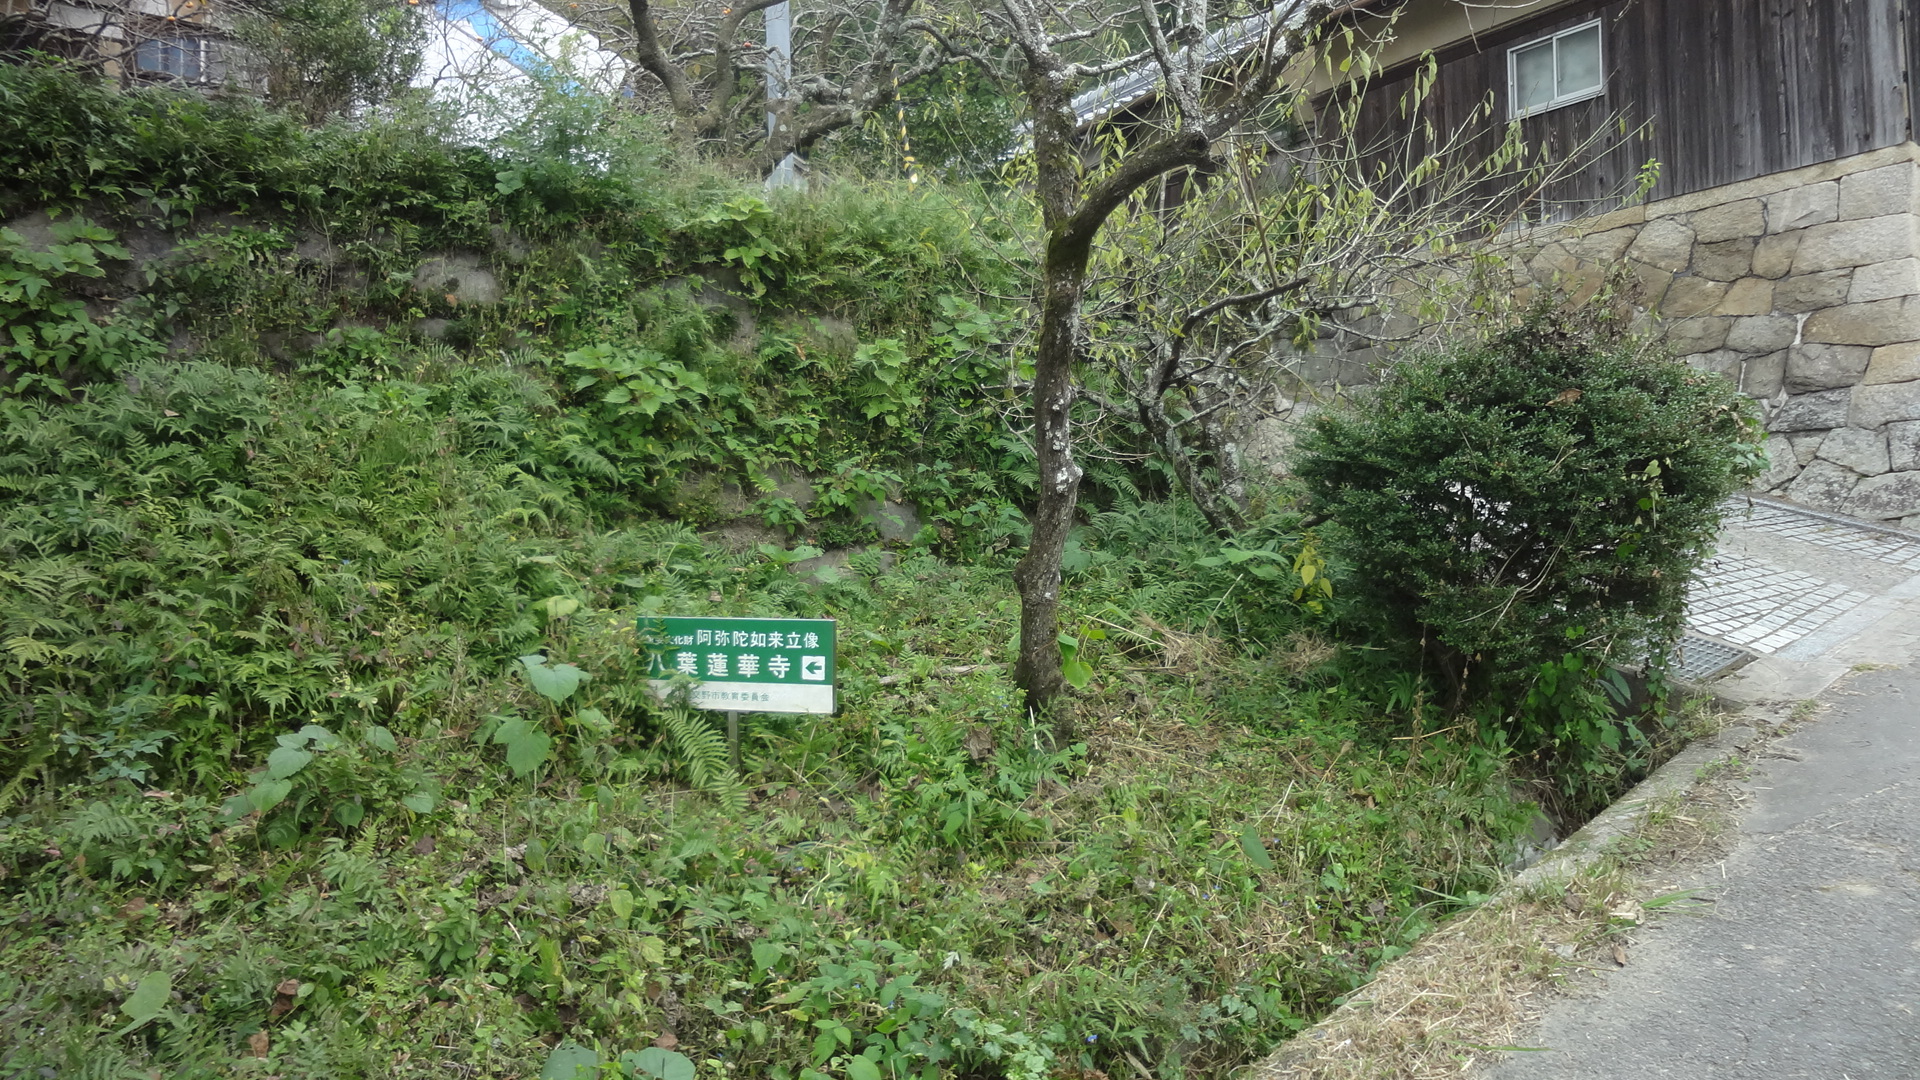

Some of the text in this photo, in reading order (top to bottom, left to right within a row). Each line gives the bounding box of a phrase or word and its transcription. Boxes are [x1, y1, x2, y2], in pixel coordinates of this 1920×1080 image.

[697, 629, 820, 649] 阿弥陀如来立像
[647, 652, 791, 679] 八葉蓮華寺
